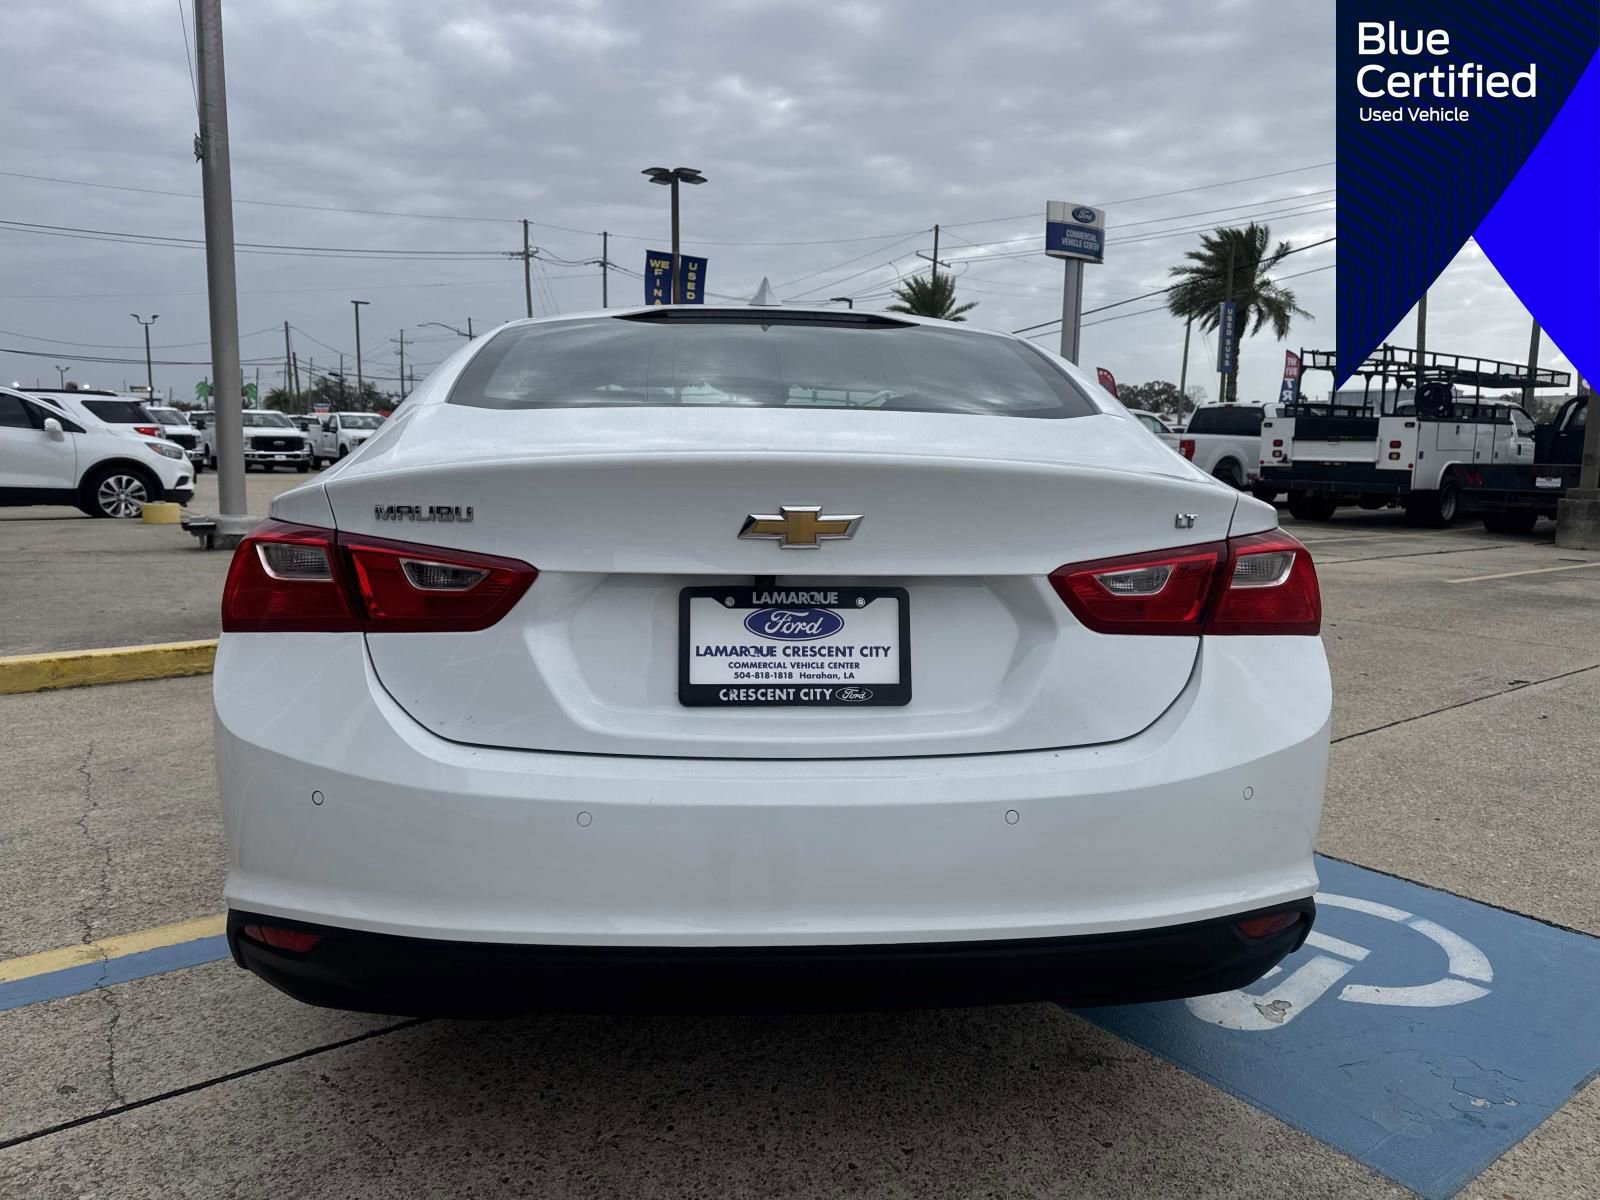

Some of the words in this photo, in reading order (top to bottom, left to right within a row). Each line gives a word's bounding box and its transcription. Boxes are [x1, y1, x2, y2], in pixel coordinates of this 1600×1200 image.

[1065, 229, 1097, 242] COMMERCIAL
[1061, 236, 1083, 249] VEHICLE
[649, 259, 670, 269] WE
[686, 262, 698, 300] USED
[374, 504, 474, 522] MALIBU
[1175, 513, 1199, 529] LT
[752, 591, 839, 605] LAMARQUE
[764, 610, 823, 635] Ford
[695, 645, 777, 658] LAMARQUE
[782, 645, 855, 658] CRESCENT
[859, 645, 891, 658] CITY
[728, 661, 788, 669] COMMERCIAL
[790, 661, 825, 669] VEHICLE
[828, 661, 860, 669] CENTER
[734, 671, 794, 680] 504-818-1818
[799, 671, 841, 680] Harahan,
[843, 671, 855, 680] LA
[719, 688, 796, 701] CRESCENT
[799, 688, 833, 701] CITY
[841, 689, 867, 700] Ford
